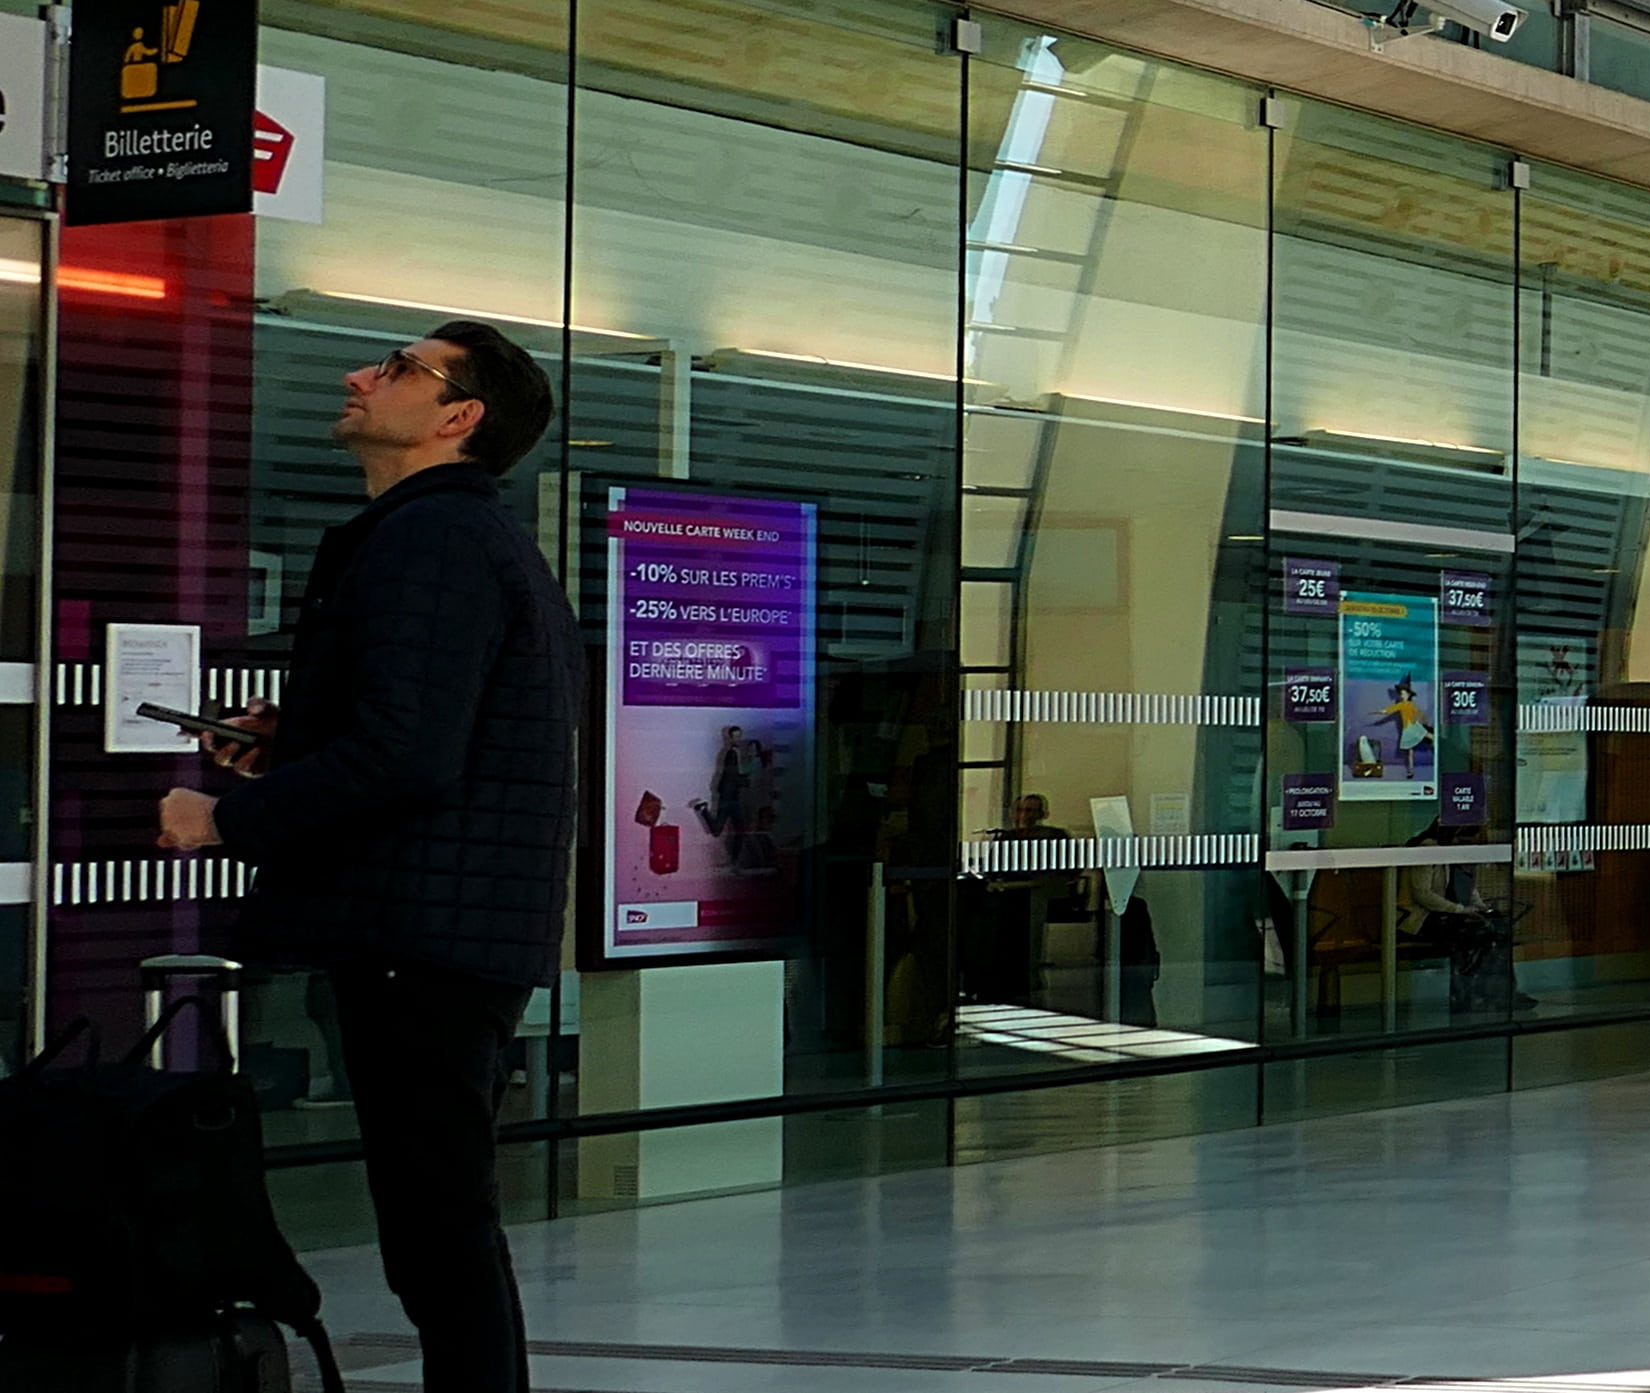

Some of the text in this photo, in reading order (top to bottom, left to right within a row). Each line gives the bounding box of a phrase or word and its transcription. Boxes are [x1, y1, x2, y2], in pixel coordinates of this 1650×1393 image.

[105, 124, 213, 157] Billetterie
[88, 159, 229, 184] Ticket office Biglietteria
[623, 520, 780, 542] NOUVELLE CARTE WEEK END
[630, 563, 677, 583] -10%
[681, 569, 709, 585] SUR
[713, 571, 737, 587] LES
[1299, 579, 1325, 597] 25€
[1449, 589, 1484, 608] 37,50€
[630, 600, 677, 619] -25%
[680, 606, 716, 621] VERS
[1348, 621, 1382, 638] -50%
[630, 641, 741, 659] ET DES OFFRES
[630, 661, 703, 679] DERNIÈRE
[1291, 685, 1331, 704] 37,50€
[1453, 691, 1477, 707] 30€
